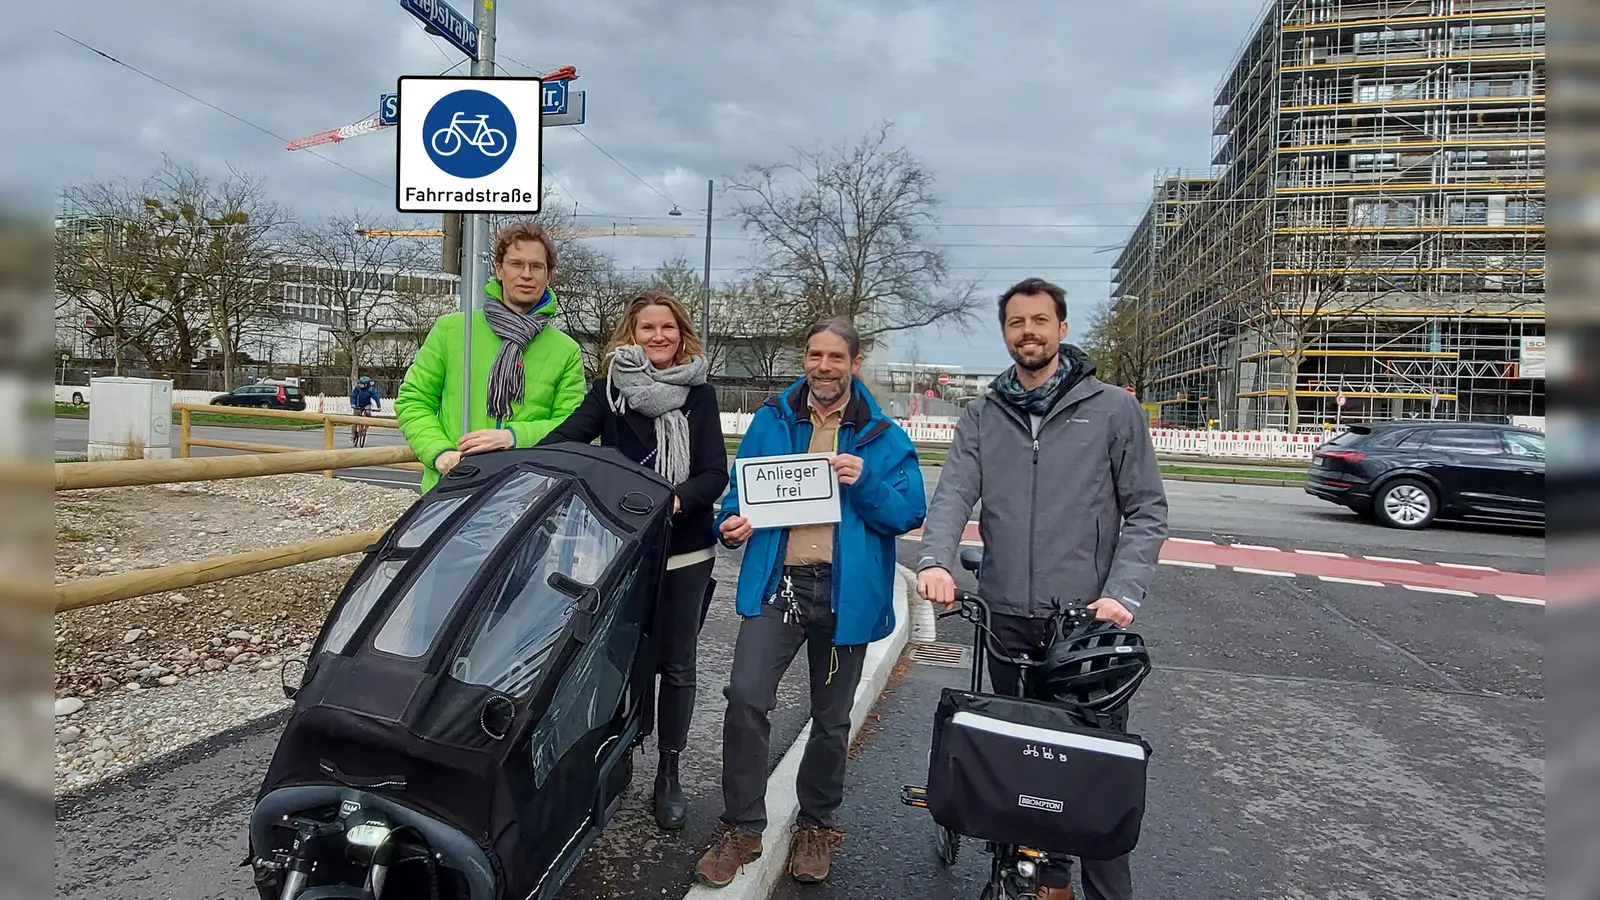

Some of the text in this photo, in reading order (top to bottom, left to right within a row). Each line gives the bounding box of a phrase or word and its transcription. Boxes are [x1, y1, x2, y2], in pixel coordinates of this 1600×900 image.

[413, 0, 476, 48] eßstraße
[386, 97, 397, 118] S
[405, 187, 532, 203] Fahrradstraße
[756, 466, 818, 482] Anlieger
[776, 483, 802, 498] frei
[1021, 797, 1061, 810] BROMPTON
